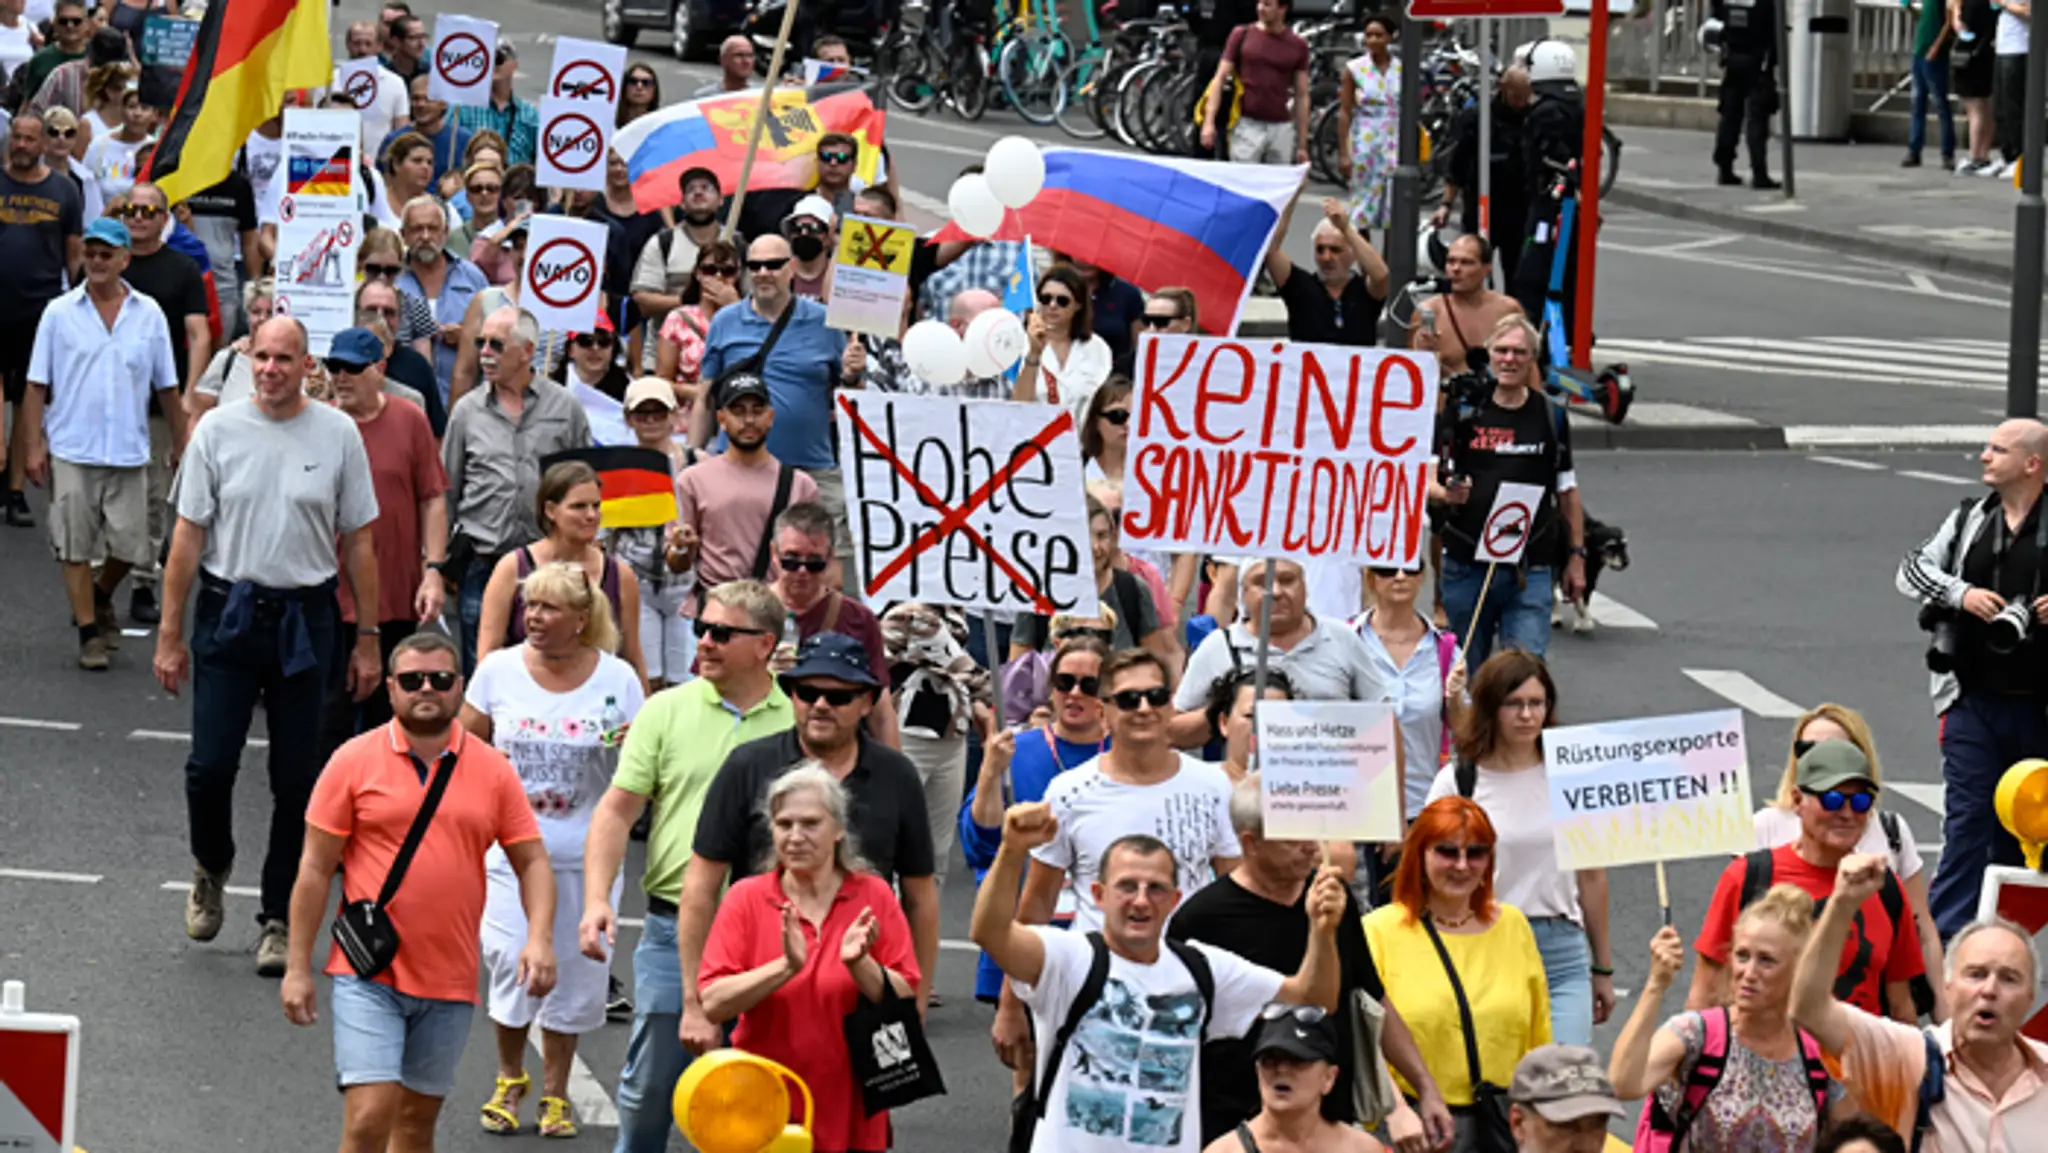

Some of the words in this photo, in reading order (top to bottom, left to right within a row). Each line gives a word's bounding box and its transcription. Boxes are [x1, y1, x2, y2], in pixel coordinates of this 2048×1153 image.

[850, 399, 1054, 519] Hohe
[859, 499, 1080, 610] Preise
[1296, 722, 1318, 738] und
[1320, 723, 1357, 738] Hetze
[1555, 730, 1740, 766] Rüstungsexporte
[1268, 780, 1300, 796] Liebe
[1302, 780, 1342, 796] Presse
[1562, 772, 1709, 811] VERBIETEN
